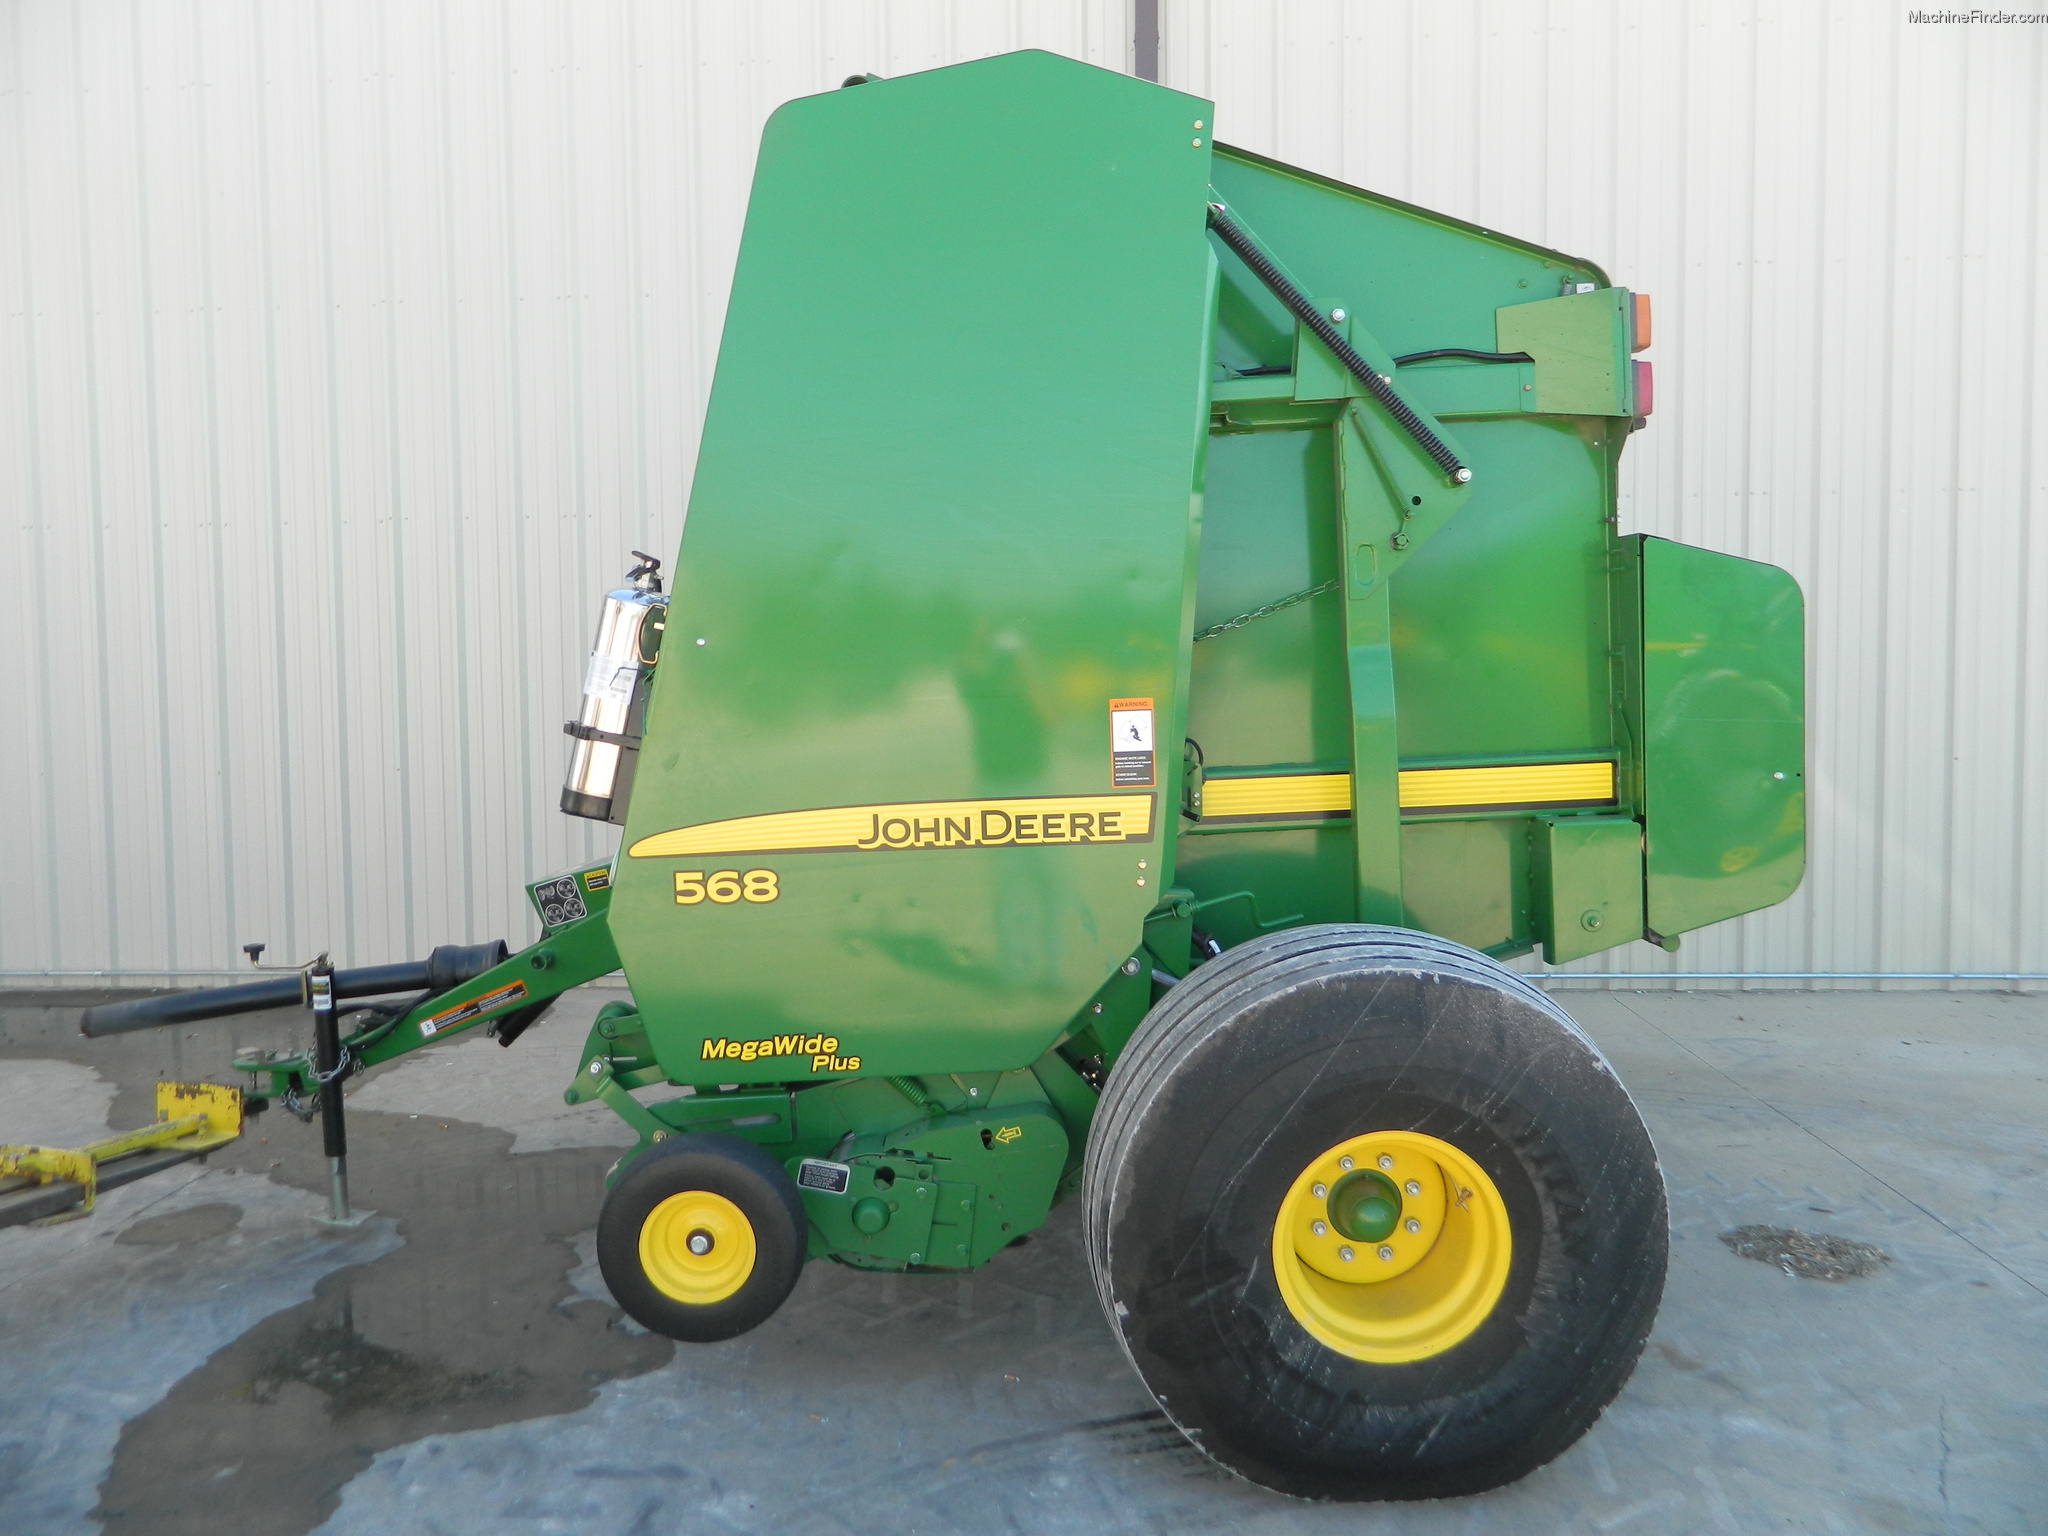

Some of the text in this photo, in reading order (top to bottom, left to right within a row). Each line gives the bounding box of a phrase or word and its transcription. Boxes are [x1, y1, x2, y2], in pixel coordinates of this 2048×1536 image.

[858, 810, 1122, 845] JOHN DEERE
[674, 868, 780, 904] 568
[701, 1032, 839, 1062] MegaWide
[811, 1053, 862, 1073] Plus
